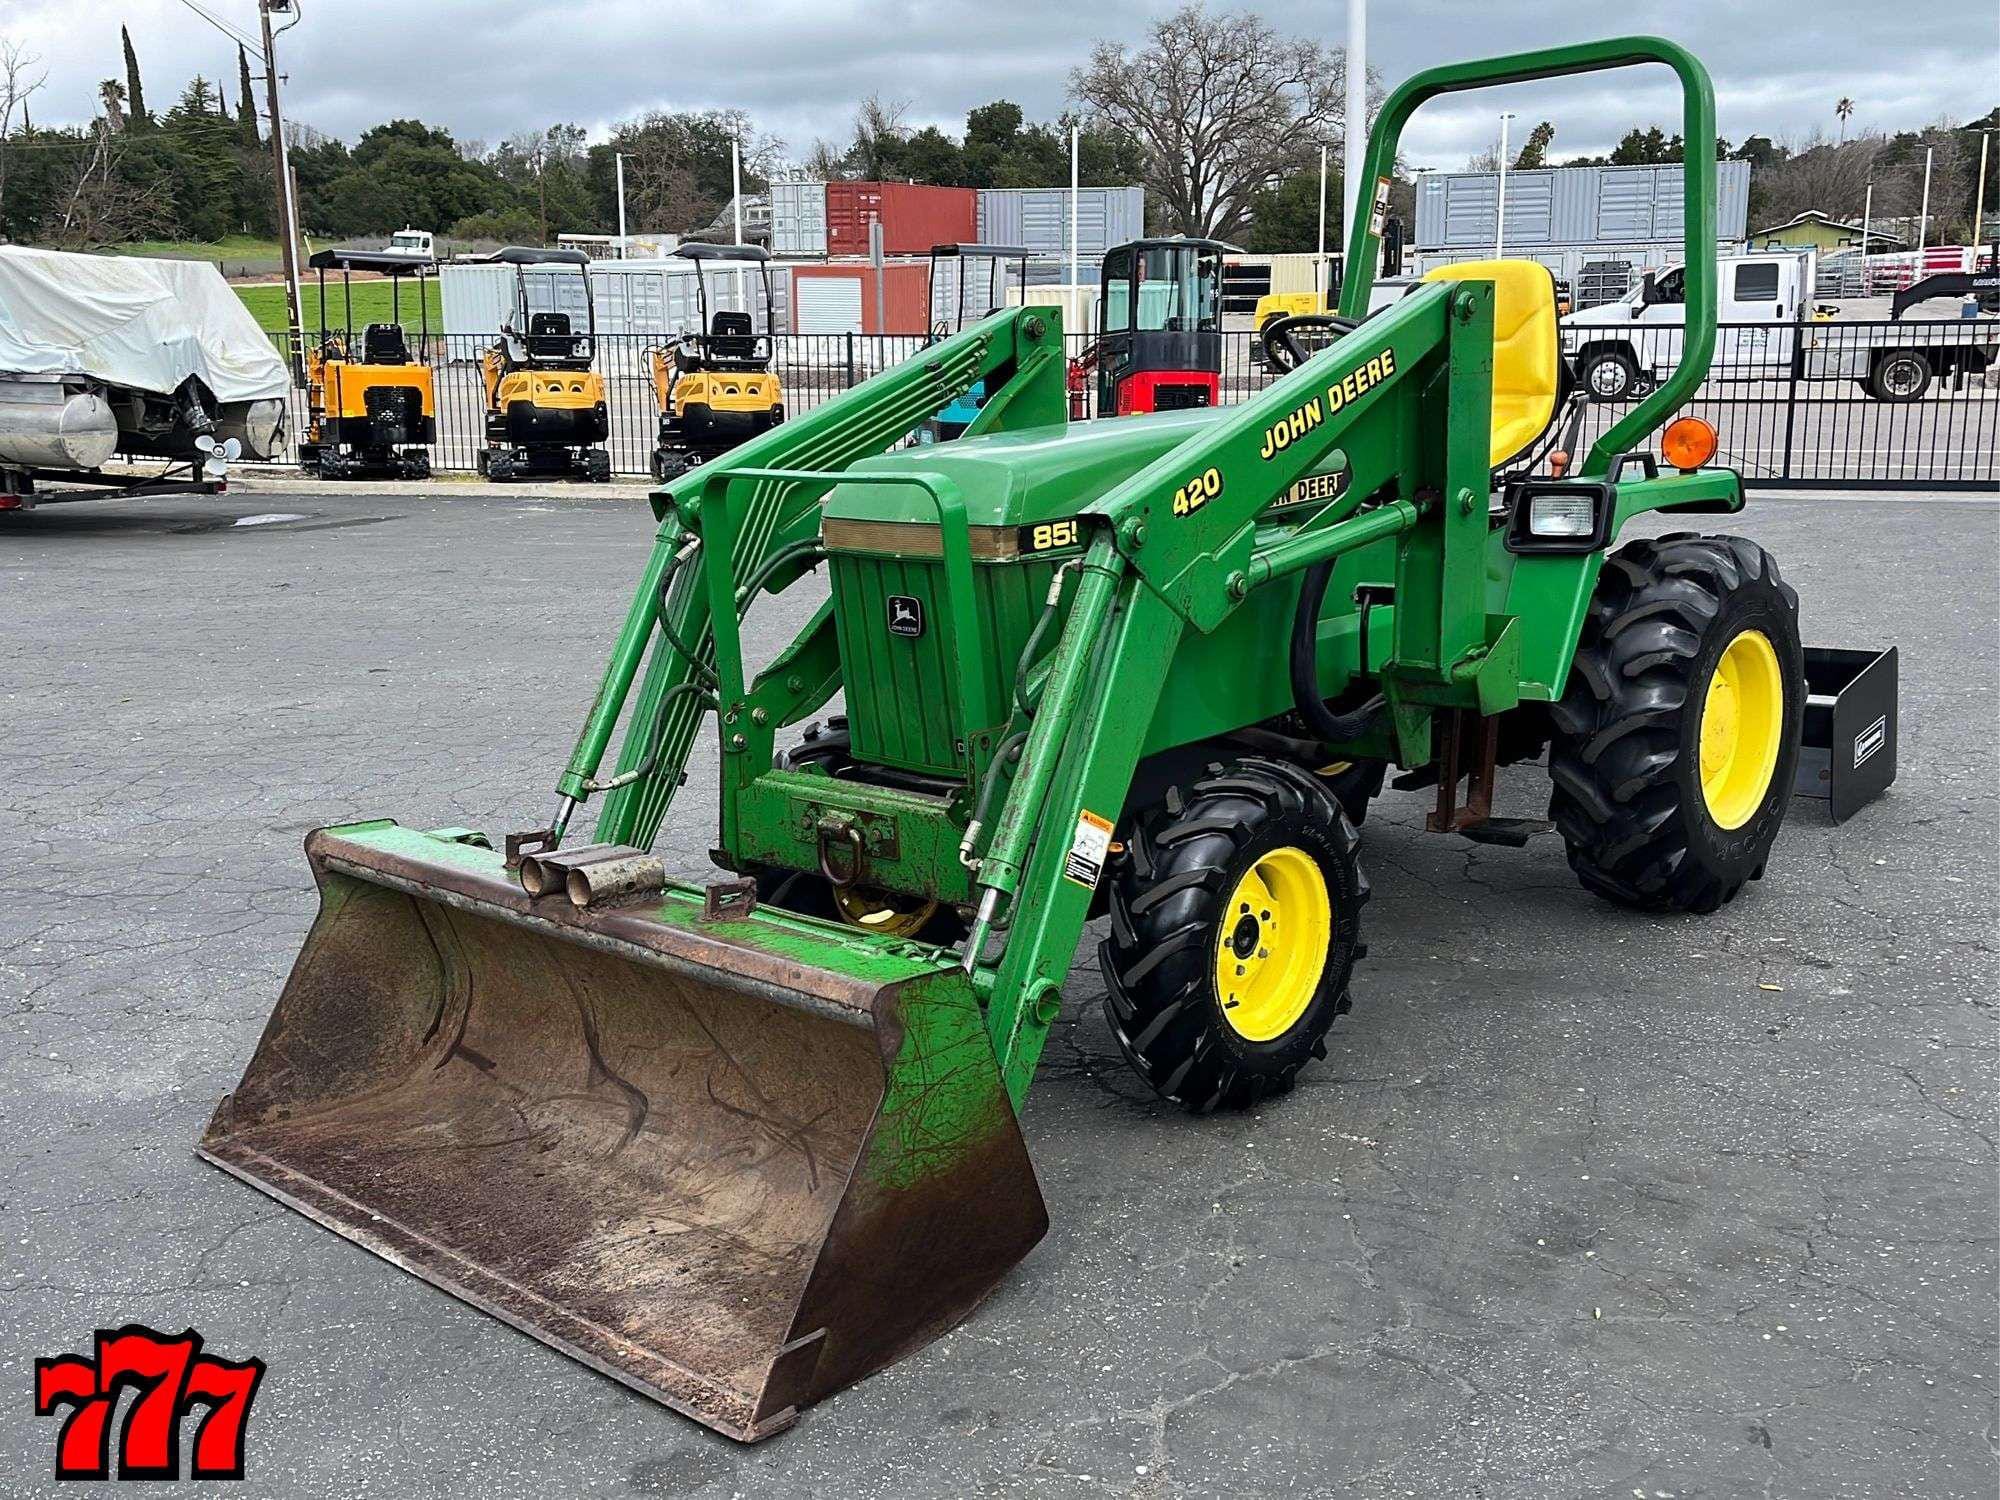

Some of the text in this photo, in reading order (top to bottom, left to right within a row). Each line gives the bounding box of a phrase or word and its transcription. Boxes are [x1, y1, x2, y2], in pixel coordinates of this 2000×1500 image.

[1260, 348, 1396, 460] JOHN DEERE
[1173, 467, 1222, 516] 420
